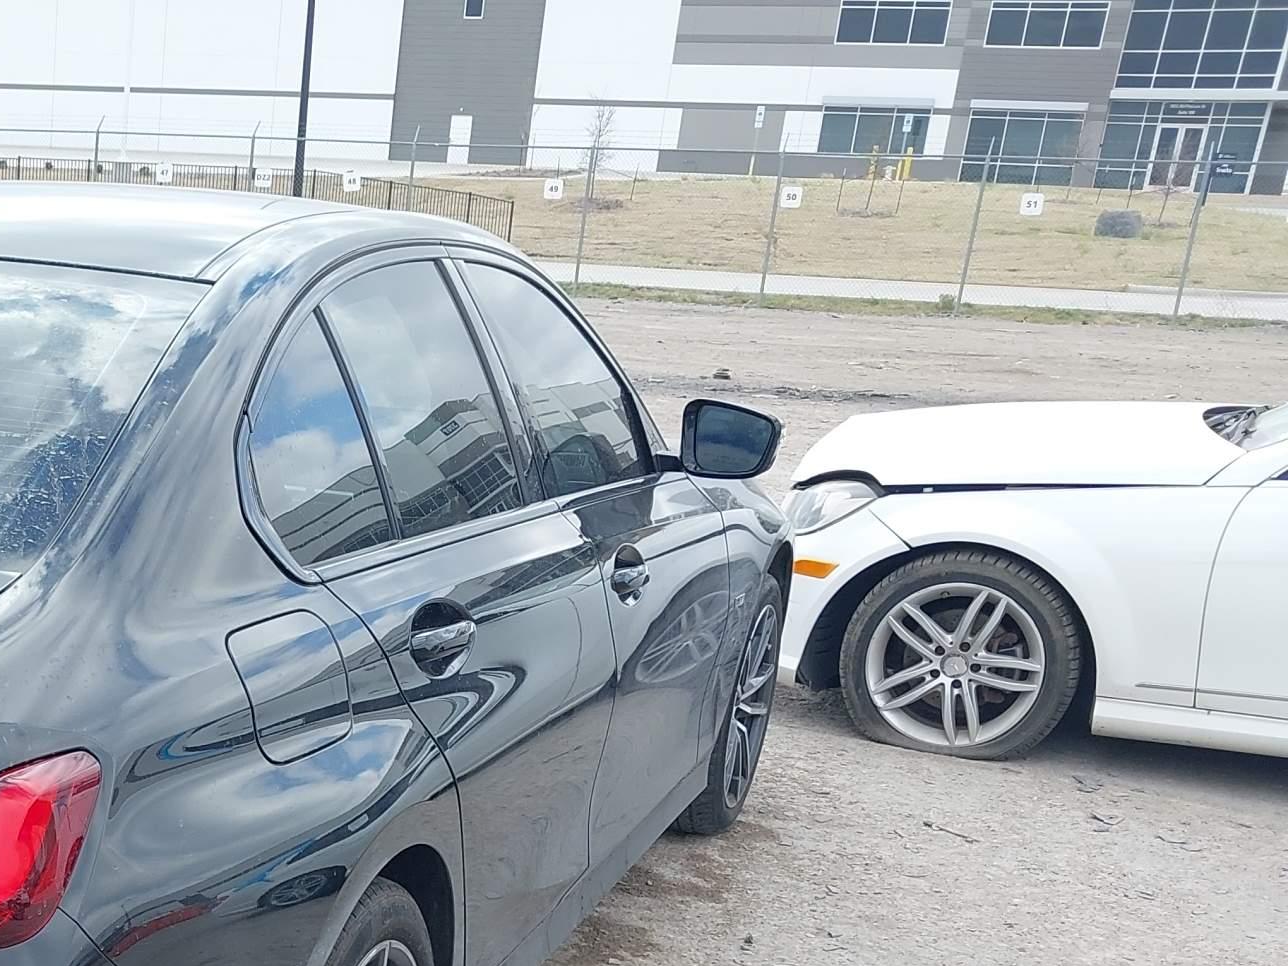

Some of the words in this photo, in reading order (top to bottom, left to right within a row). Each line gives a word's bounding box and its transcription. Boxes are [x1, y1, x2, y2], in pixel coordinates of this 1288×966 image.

[548, 185, 559, 193] 49
[786, 193, 797, 201] 50
[1025, 200, 1038, 209] 51
